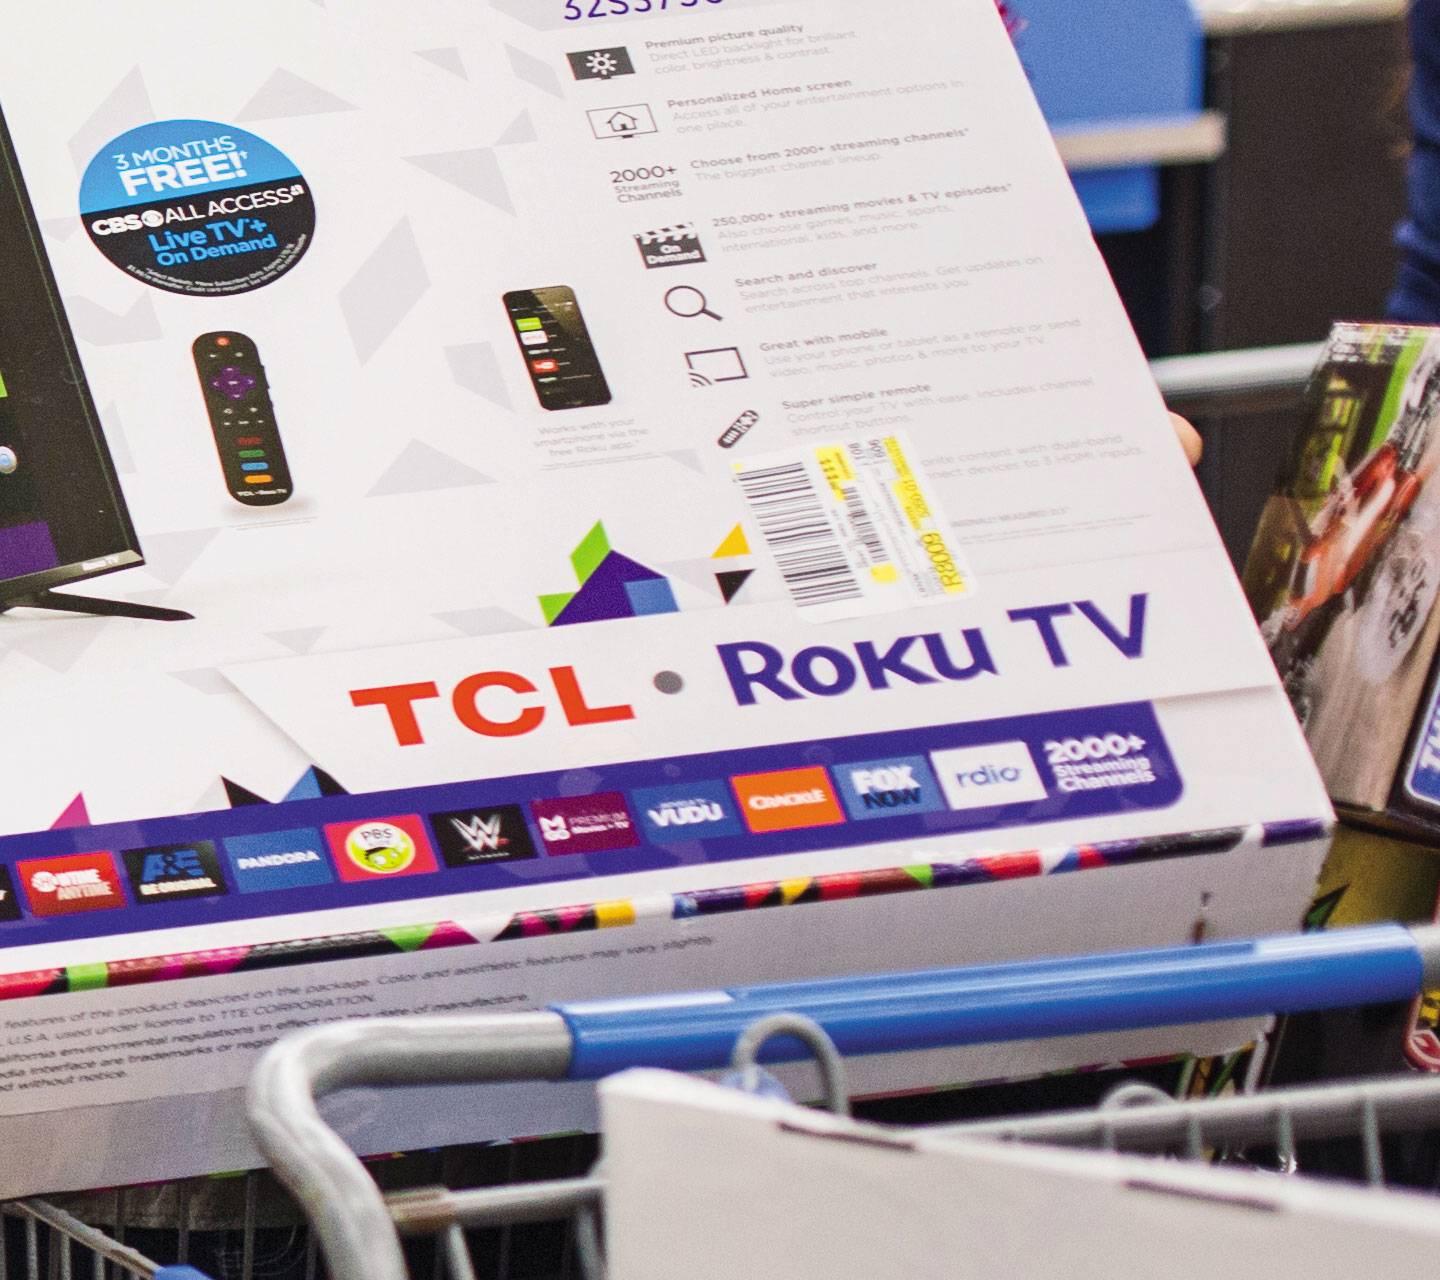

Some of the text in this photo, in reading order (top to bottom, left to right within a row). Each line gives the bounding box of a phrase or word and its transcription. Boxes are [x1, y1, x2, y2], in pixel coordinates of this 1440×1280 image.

[644, 24, 803, 49] Premium picture quality
[666, 79, 852, 108] Personalized Home screen
[112, 135, 237, 170] 3 MONTHS
[689, 156, 743, 169] Choose
[745, 151, 781, 162] from
[783, 144, 825, 157] 2000+
[829, 136, 900, 152] streaming
[609, 165, 677, 183] 2000+
[614, 180, 681, 193] Streaming
[617, 188, 683, 203] Channels
[778, 202, 850, 219] streaming
[852, 196, 904, 209] movies
[919, 190, 939, 200] TV
[91, 211, 143, 236] CBS
[147, 230, 208, 253] Live
[156, 233, 278, 267] On Demand
[733, 262, 877, 287] Search and discover
[347, 592, 1151, 747] TCL Roku TV
[1042, 732, 1147, 764] 2000+
[850, 766, 922, 793] FOX
[1052, 756, 1151, 782] Streaming
[1056, 768, 1157, 794] Channels
[862, 786, 924, 809] NOW
[646, 800, 725, 827] VUDU
[360, 827, 394, 842] PBS
[236, 850, 321, 870] PANDORA
